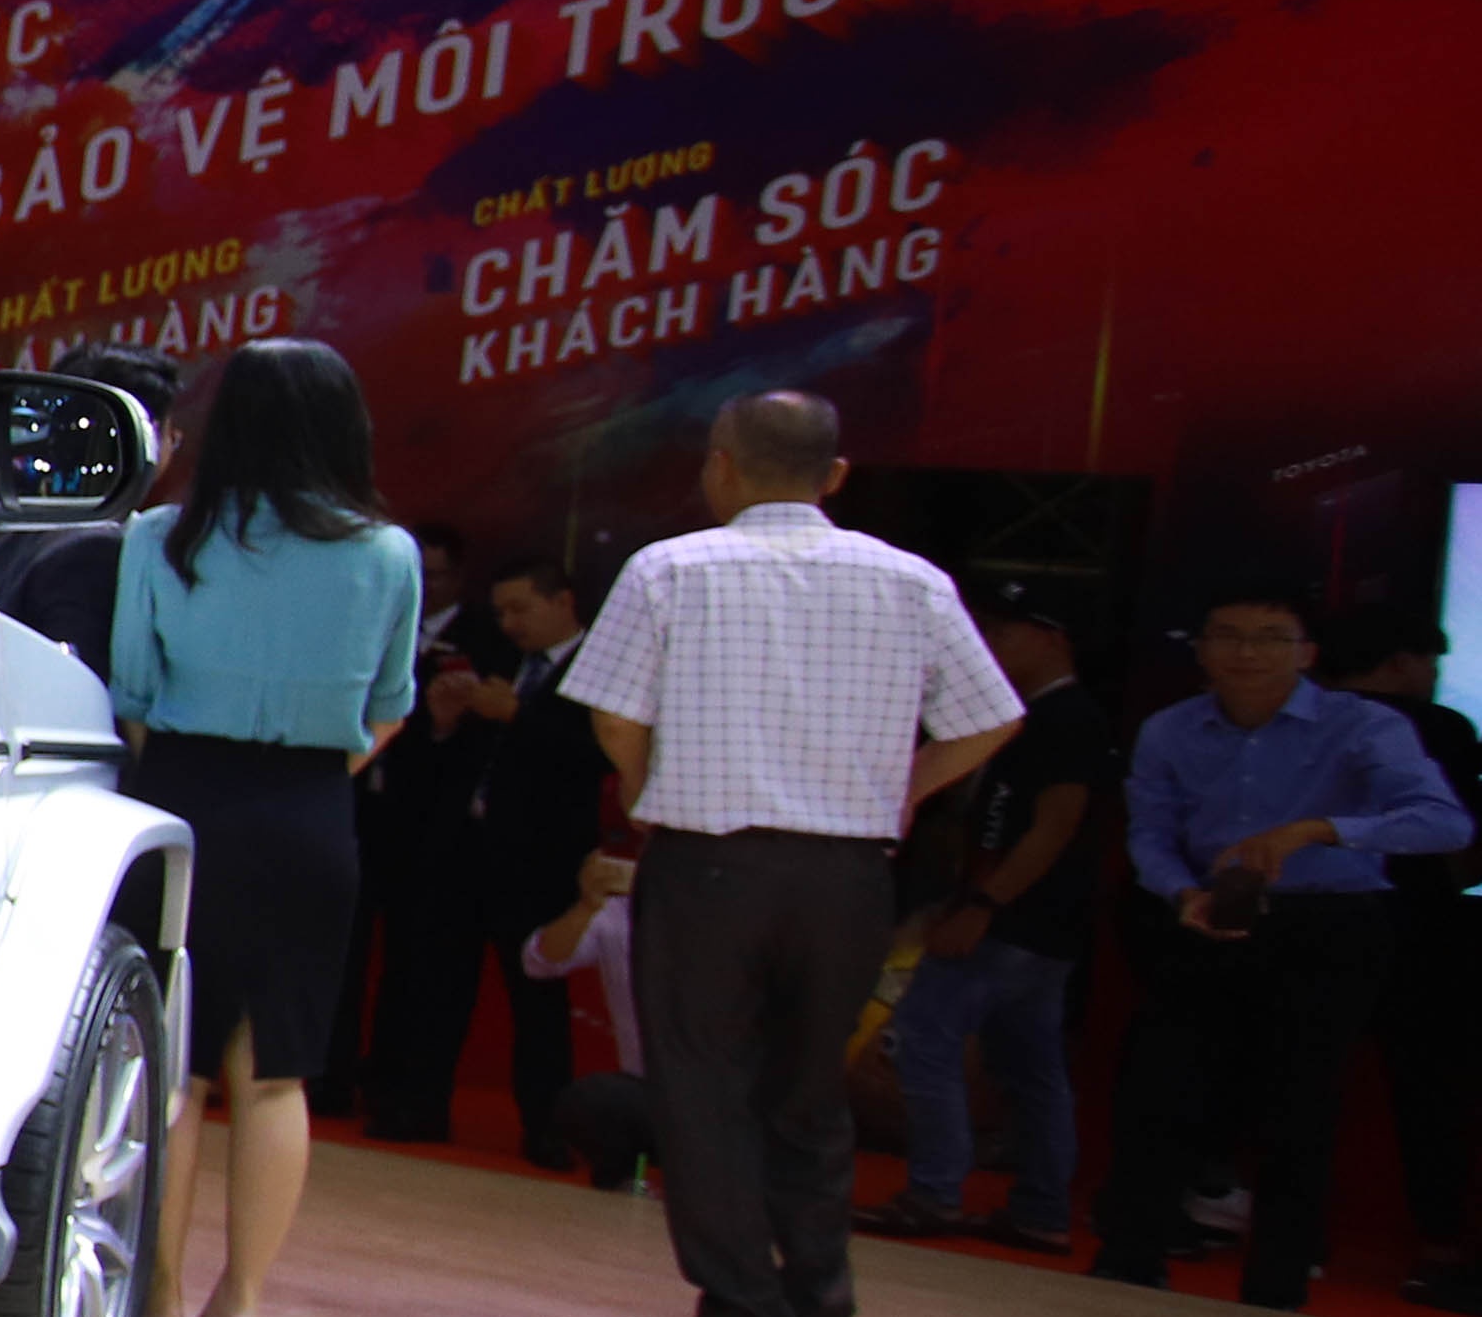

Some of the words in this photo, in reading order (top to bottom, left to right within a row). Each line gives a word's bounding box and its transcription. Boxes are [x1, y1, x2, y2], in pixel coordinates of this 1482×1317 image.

[177, 66, 295, 177] VỆ
[328, 17, 514, 140] MÔI
[459, 282, 700, 385] KHÁCH
[727, 227, 942, 323] HÀNG
[461, 192, 720, 318] CHĂM
[756, 138, 948, 246] SÓC
